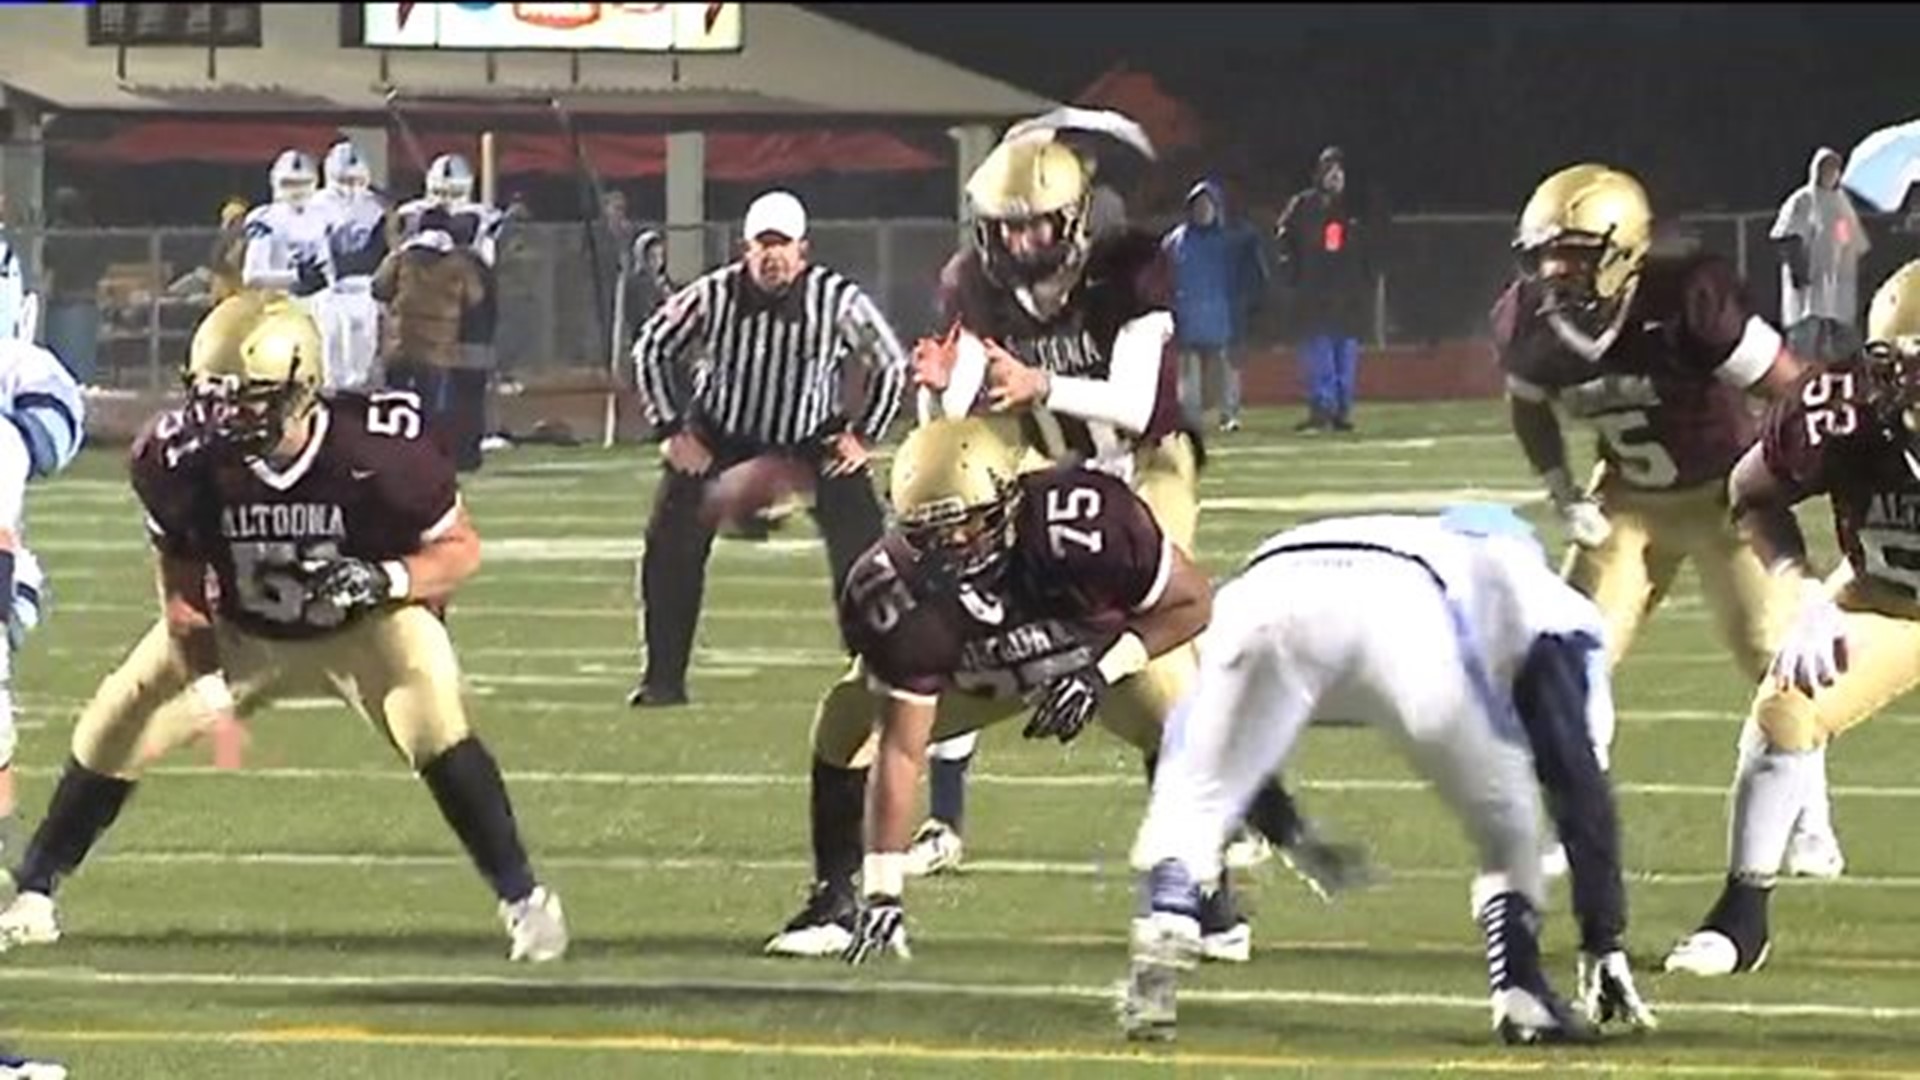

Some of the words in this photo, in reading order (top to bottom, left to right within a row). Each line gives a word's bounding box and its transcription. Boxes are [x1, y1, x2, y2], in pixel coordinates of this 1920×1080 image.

[1802, 372, 1857, 446] 52
[221, 502, 347, 539] ALTOONA
[1047, 487, 1103, 557] 75
